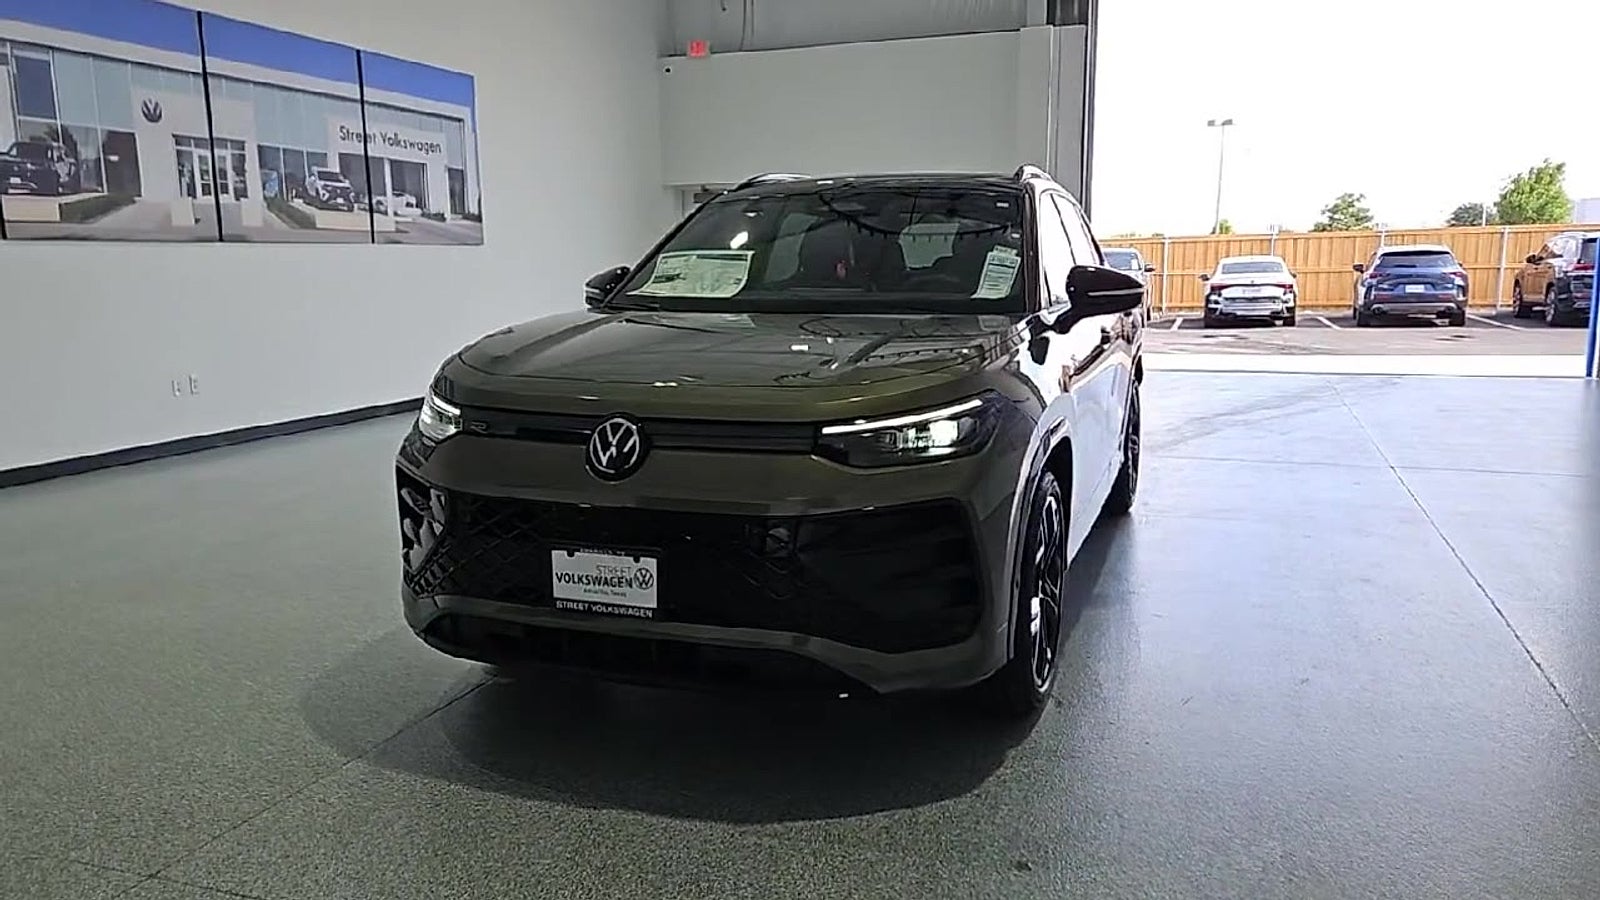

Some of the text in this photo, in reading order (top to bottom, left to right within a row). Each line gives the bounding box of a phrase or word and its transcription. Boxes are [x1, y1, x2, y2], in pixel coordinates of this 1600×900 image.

[339, 125, 442, 155] Street Volkswagen
[596, 565, 632, 577] STREET
[555, 572, 634, 589] VOLKSWAGEN
[556, 600, 653, 618] STREET VOLKSWAGEN
